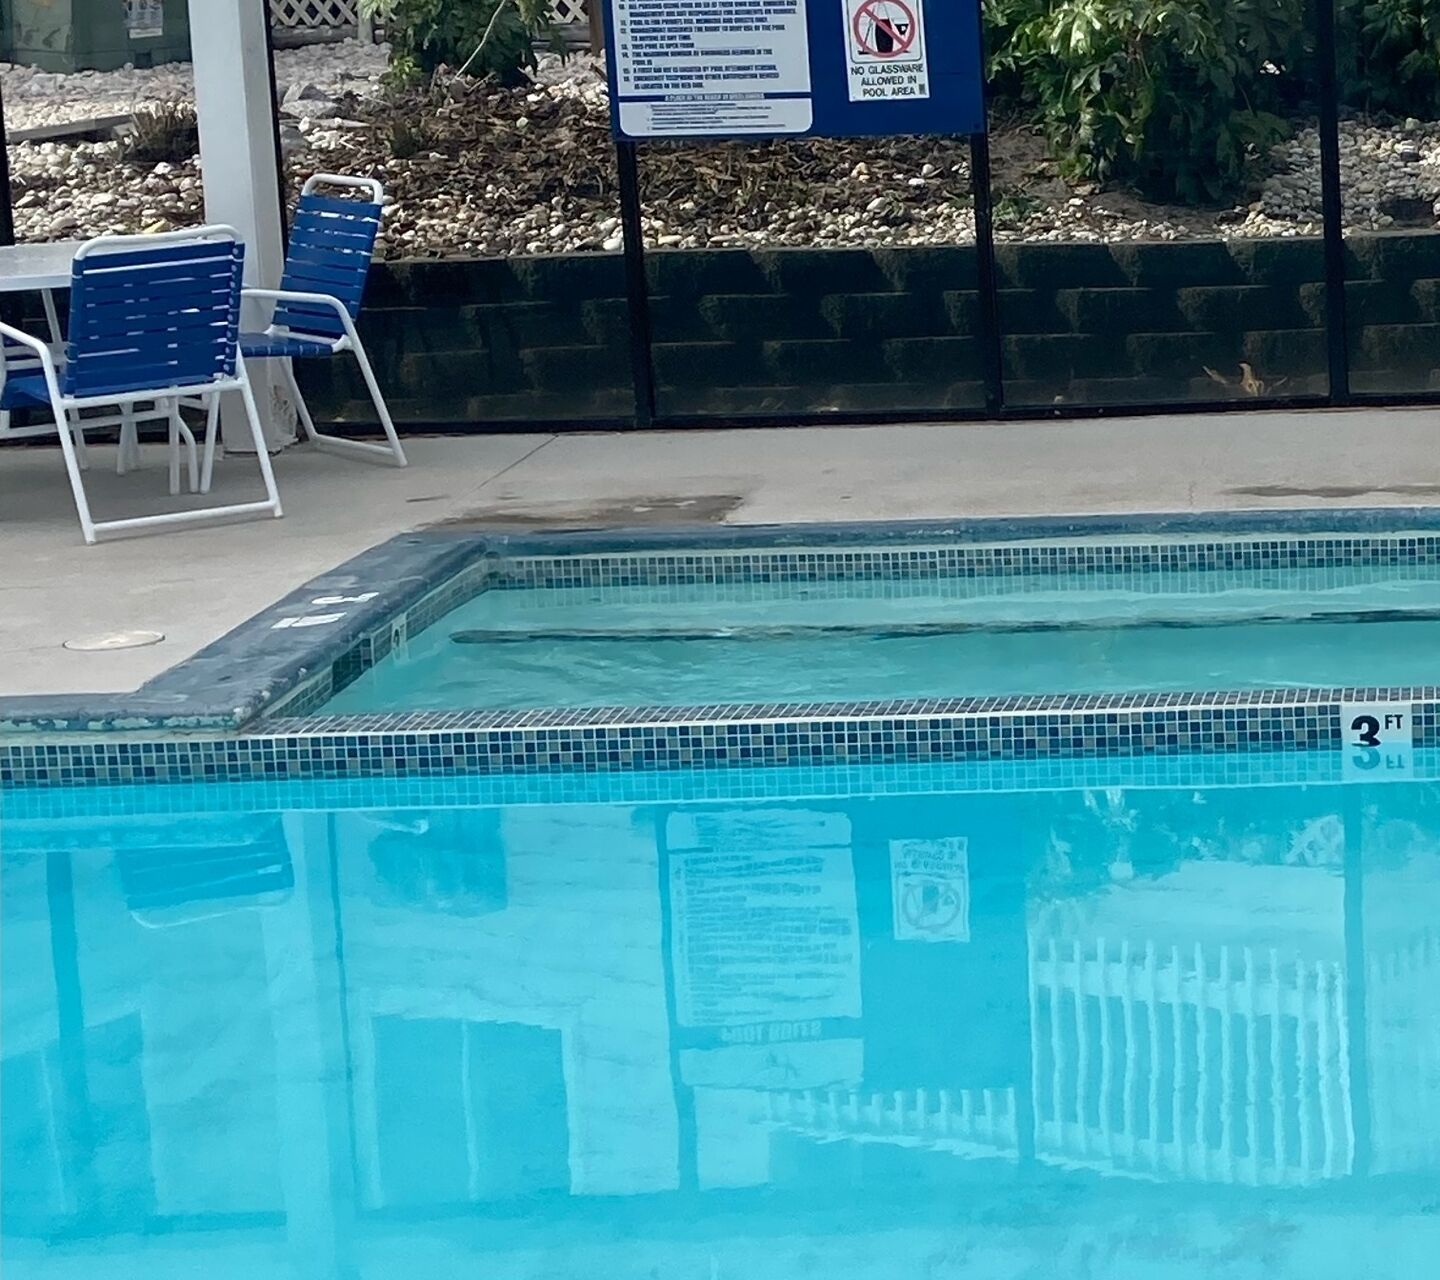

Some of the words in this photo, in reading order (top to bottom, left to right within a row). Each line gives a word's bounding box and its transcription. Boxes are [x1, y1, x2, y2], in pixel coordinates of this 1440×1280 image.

[851, 66, 864, 75] NO
[868, 64, 923, 74] GLASSWARE
[861, 76, 903, 86] ALLOWED
[908, 76, 916, 84] IN
[863, 88, 887, 97] POOL
[891, 87, 915, 96] AREA
[1351, 715, 1381, 747] 3
[1385, 714, 1403, 729] FT
